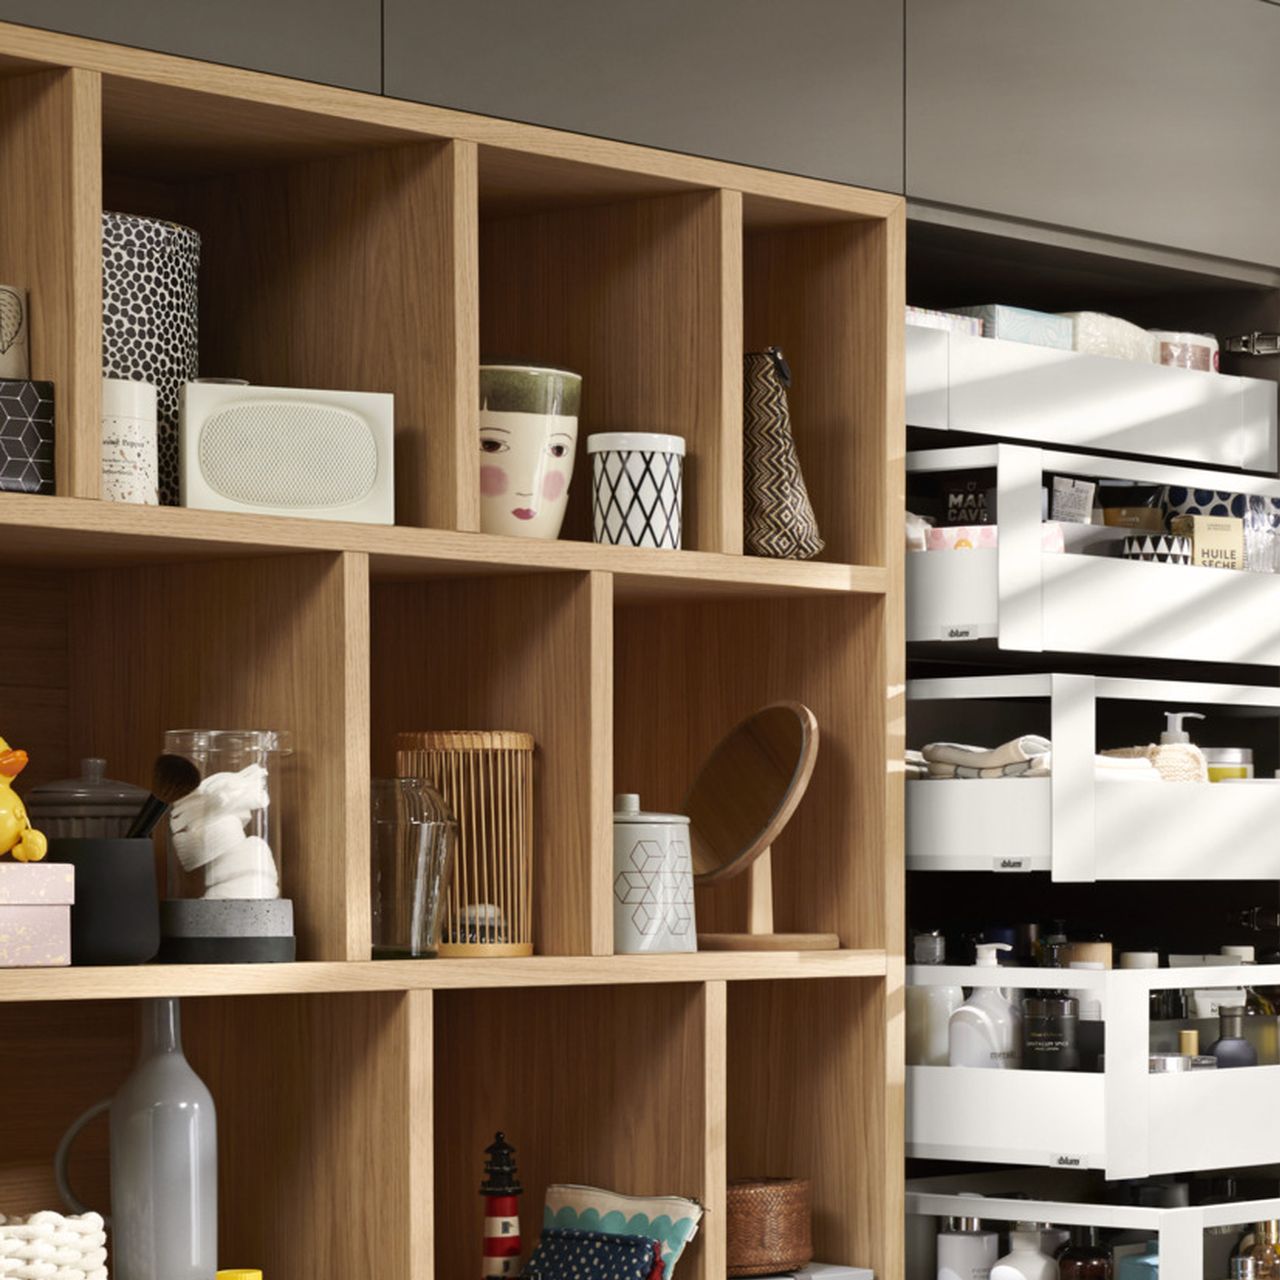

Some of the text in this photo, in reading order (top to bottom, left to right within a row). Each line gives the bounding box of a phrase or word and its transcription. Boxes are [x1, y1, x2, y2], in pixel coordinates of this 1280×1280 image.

[1201, 549, 1236, 560] HUILE
[949, 629, 970, 638] blum
[1001, 859, 1022, 868] blum
[1057, 1156, 1080, 1165] blum
